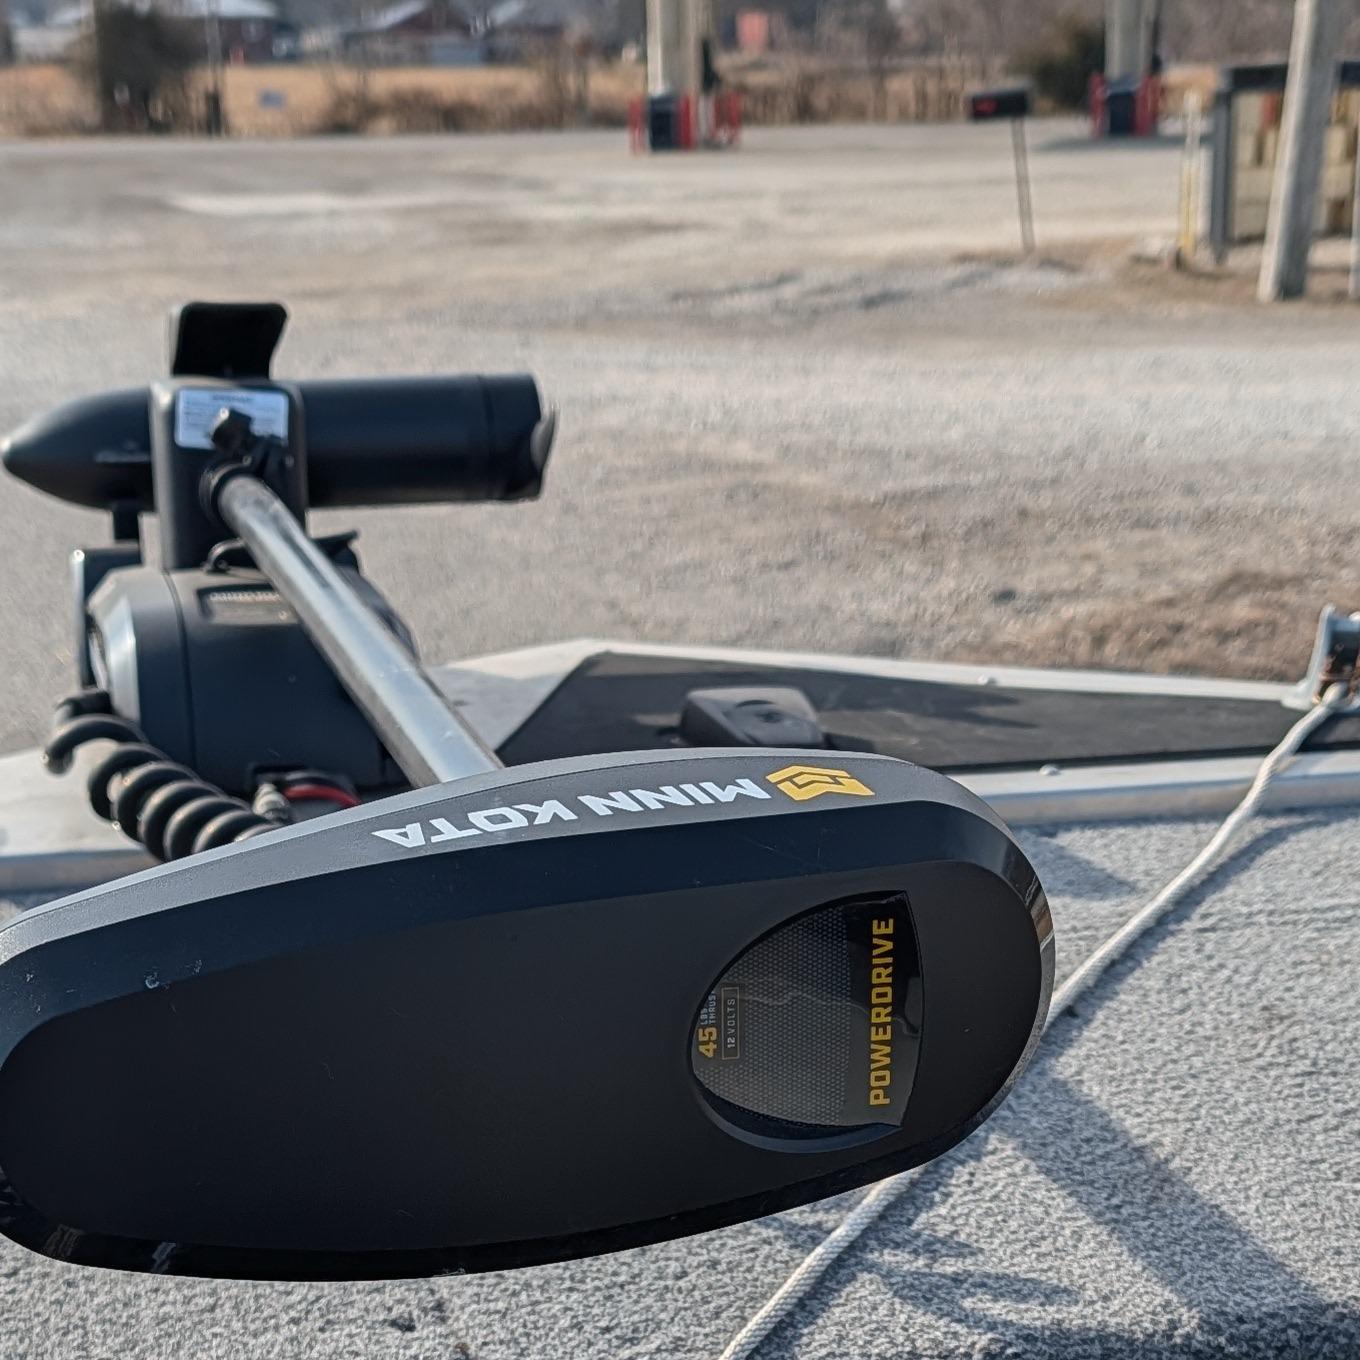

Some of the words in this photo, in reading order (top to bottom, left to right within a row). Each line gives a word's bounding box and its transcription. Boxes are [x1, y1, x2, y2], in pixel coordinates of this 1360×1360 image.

[577, 778, 771, 816] MINN
[371, 804, 579, 848] KOTA
[727, 999, 736, 1034] VOLTS
[869, 918, 894, 1105] POWERDRIVE
[698, 1027, 717, 1058] 45
[727, 1037, 736, 1048] 12
